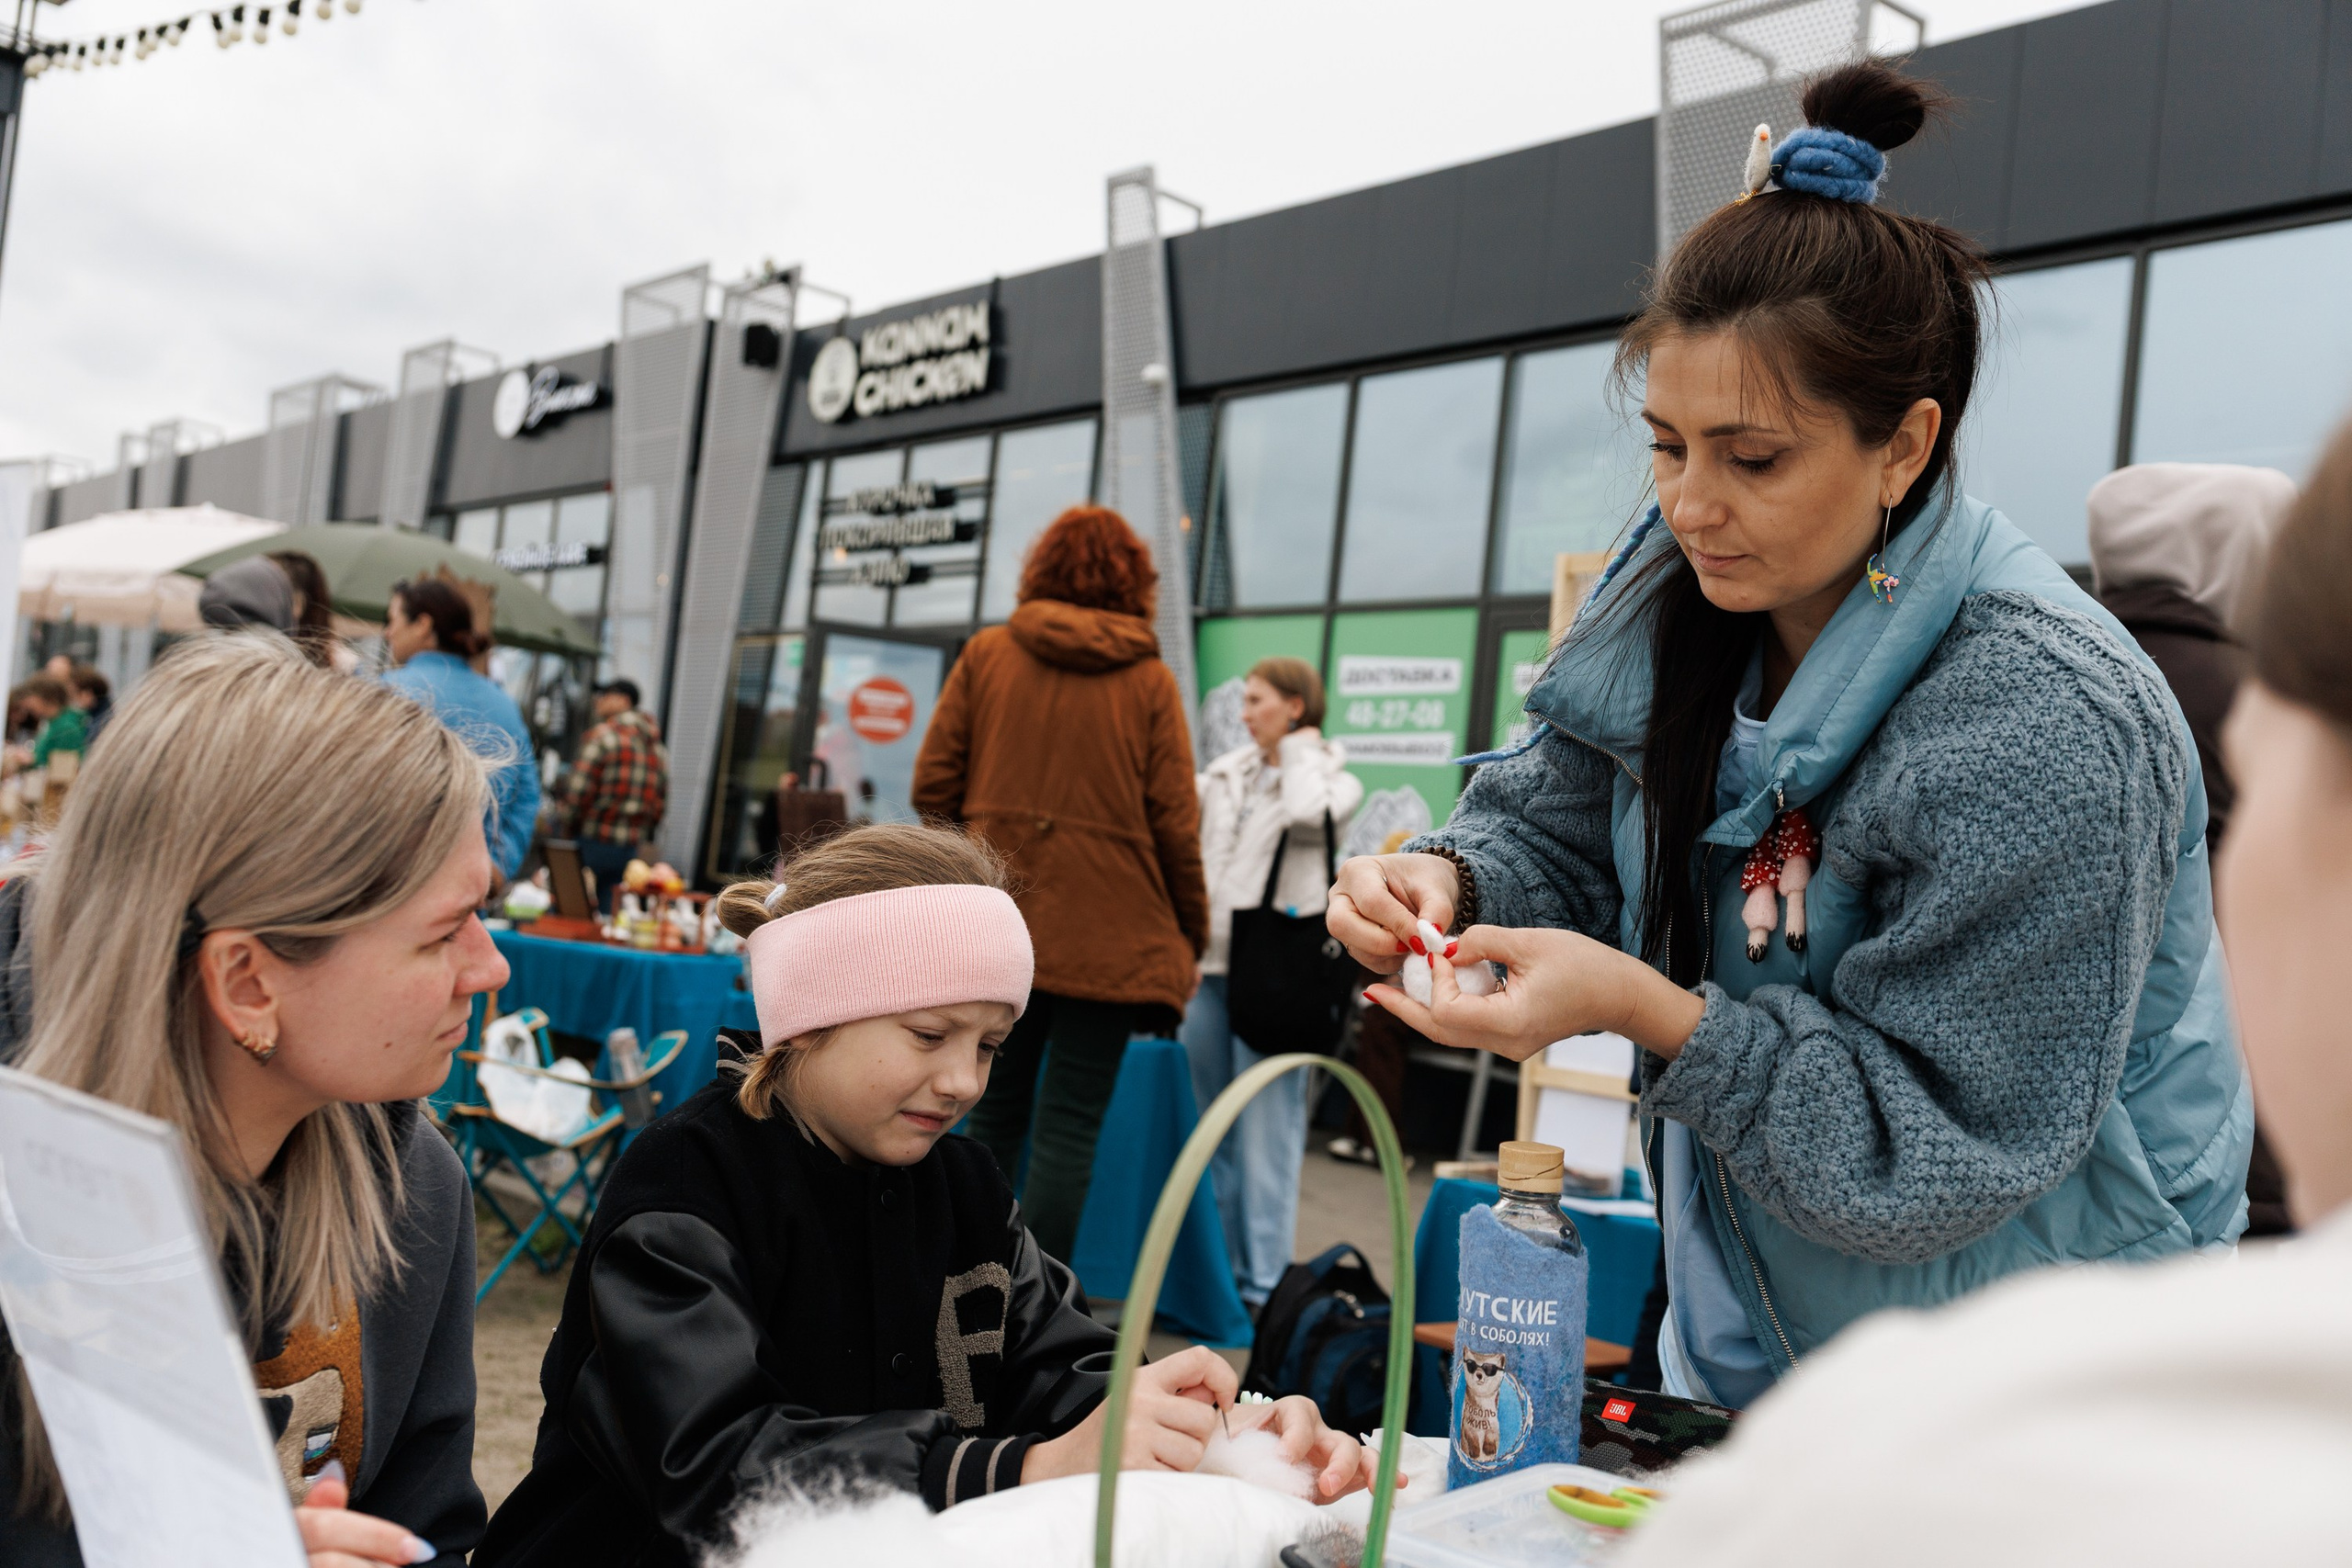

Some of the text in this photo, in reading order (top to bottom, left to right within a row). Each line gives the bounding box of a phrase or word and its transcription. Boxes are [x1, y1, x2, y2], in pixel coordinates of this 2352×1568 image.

[854, 347, 990, 418] CHICKEN
[1344, 666, 1452, 686] ДОСТАВКА
[1470, 1322, 1476, 1336] В
[1479, 1325, 1550, 1347] СОБОЛЯХ!
[1465, 1402, 1497, 1418] СОБОЛЬ
[1609, 1403, 1627, 1416] JBL
